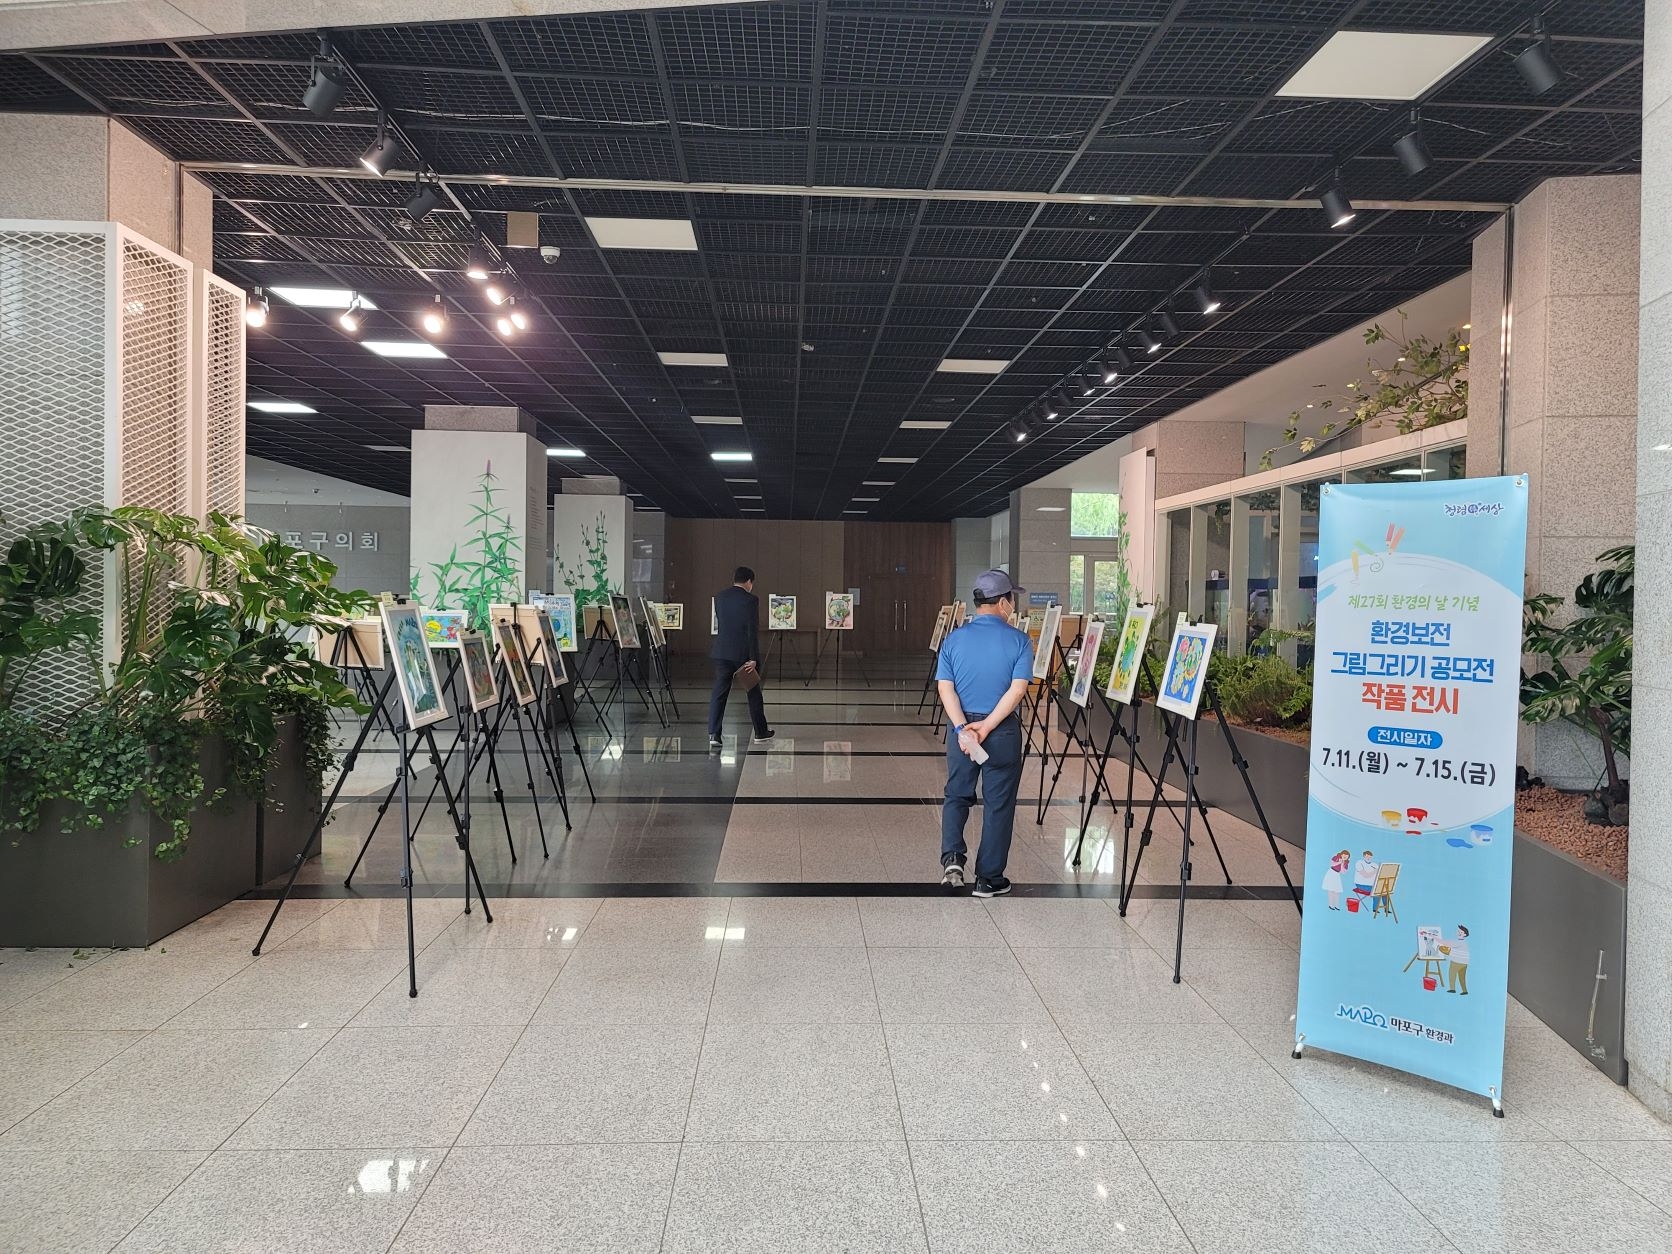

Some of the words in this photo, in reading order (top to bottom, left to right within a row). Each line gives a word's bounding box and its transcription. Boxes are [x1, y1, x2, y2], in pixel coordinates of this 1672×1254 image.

[257, 531, 379, 551] 포구의회
[1348, 594, 1388, 610] 제27회
[1391, 594, 1431, 611] 환경의
[1434, 596, 1449, 611] 날
[1452, 595, 1481, 612] 기념
[1370, 619, 1452, 647] 환경보전
[1330, 651, 1426, 679] 그림그리기
[1430, 655, 1495, 683] 공모전
[1361, 682, 1407, 712] 작품
[1411, 685, 1460, 715] 전시
[1376, 729, 1433, 746] 전시일자
[1322, 747, 1390, 775] 7.11.(월)
[1414, 757, 1496, 787] 7.15.(금)
[1390, 1017, 1424, 1037] 마포구
[1425, 1027, 1454, 1044] 환경과
